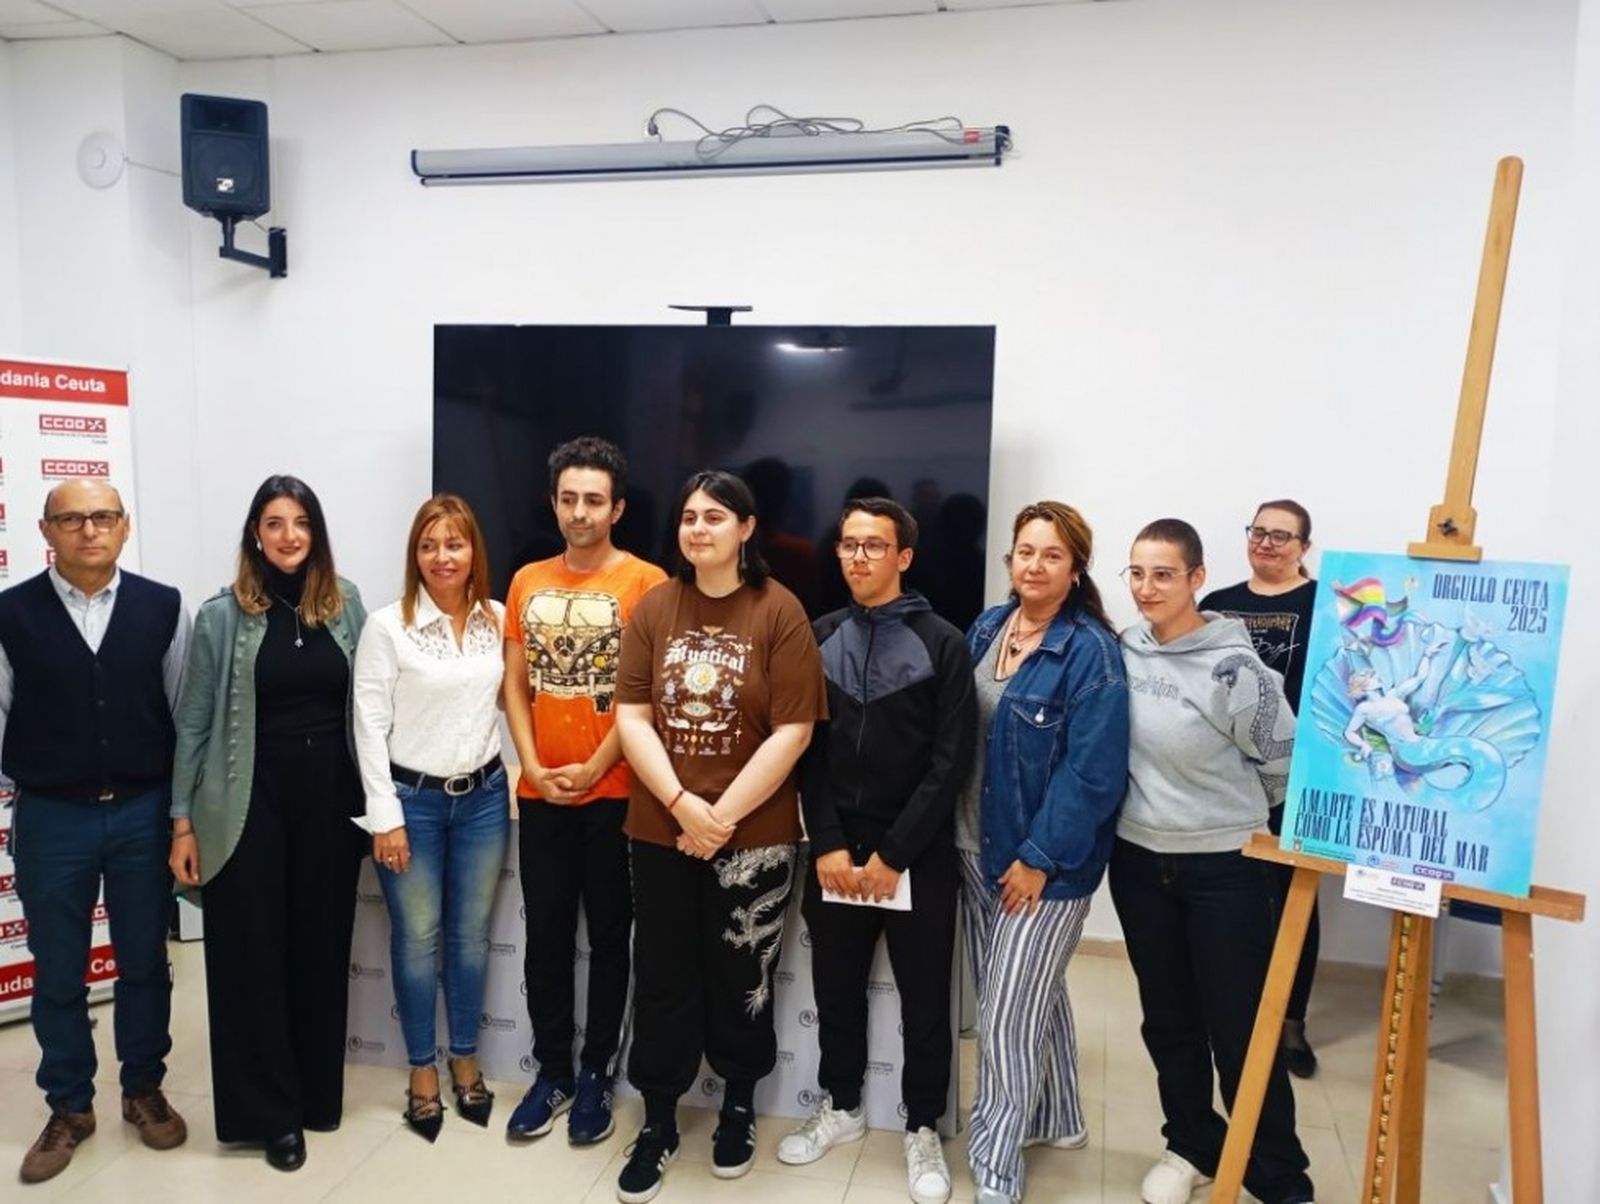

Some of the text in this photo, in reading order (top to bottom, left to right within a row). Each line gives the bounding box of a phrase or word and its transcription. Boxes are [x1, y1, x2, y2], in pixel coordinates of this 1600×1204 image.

[55, 374, 105, 393] Ceuta
[1433, 573, 1548, 607] ORGULLO CEUTA
[1507, 605, 1547, 633] 2025
[663, 645, 745, 673] Mystical
[1298, 787, 1448, 838] AMARTE ES NATURAL
[1294, 812, 1331, 842] COMO
[1335, 818, 1351, 847] LA
[1357, 823, 1411, 858] ESPUMA
[1420, 834, 1446, 864] DEL
[1455, 840, 1489, 872] MAR
